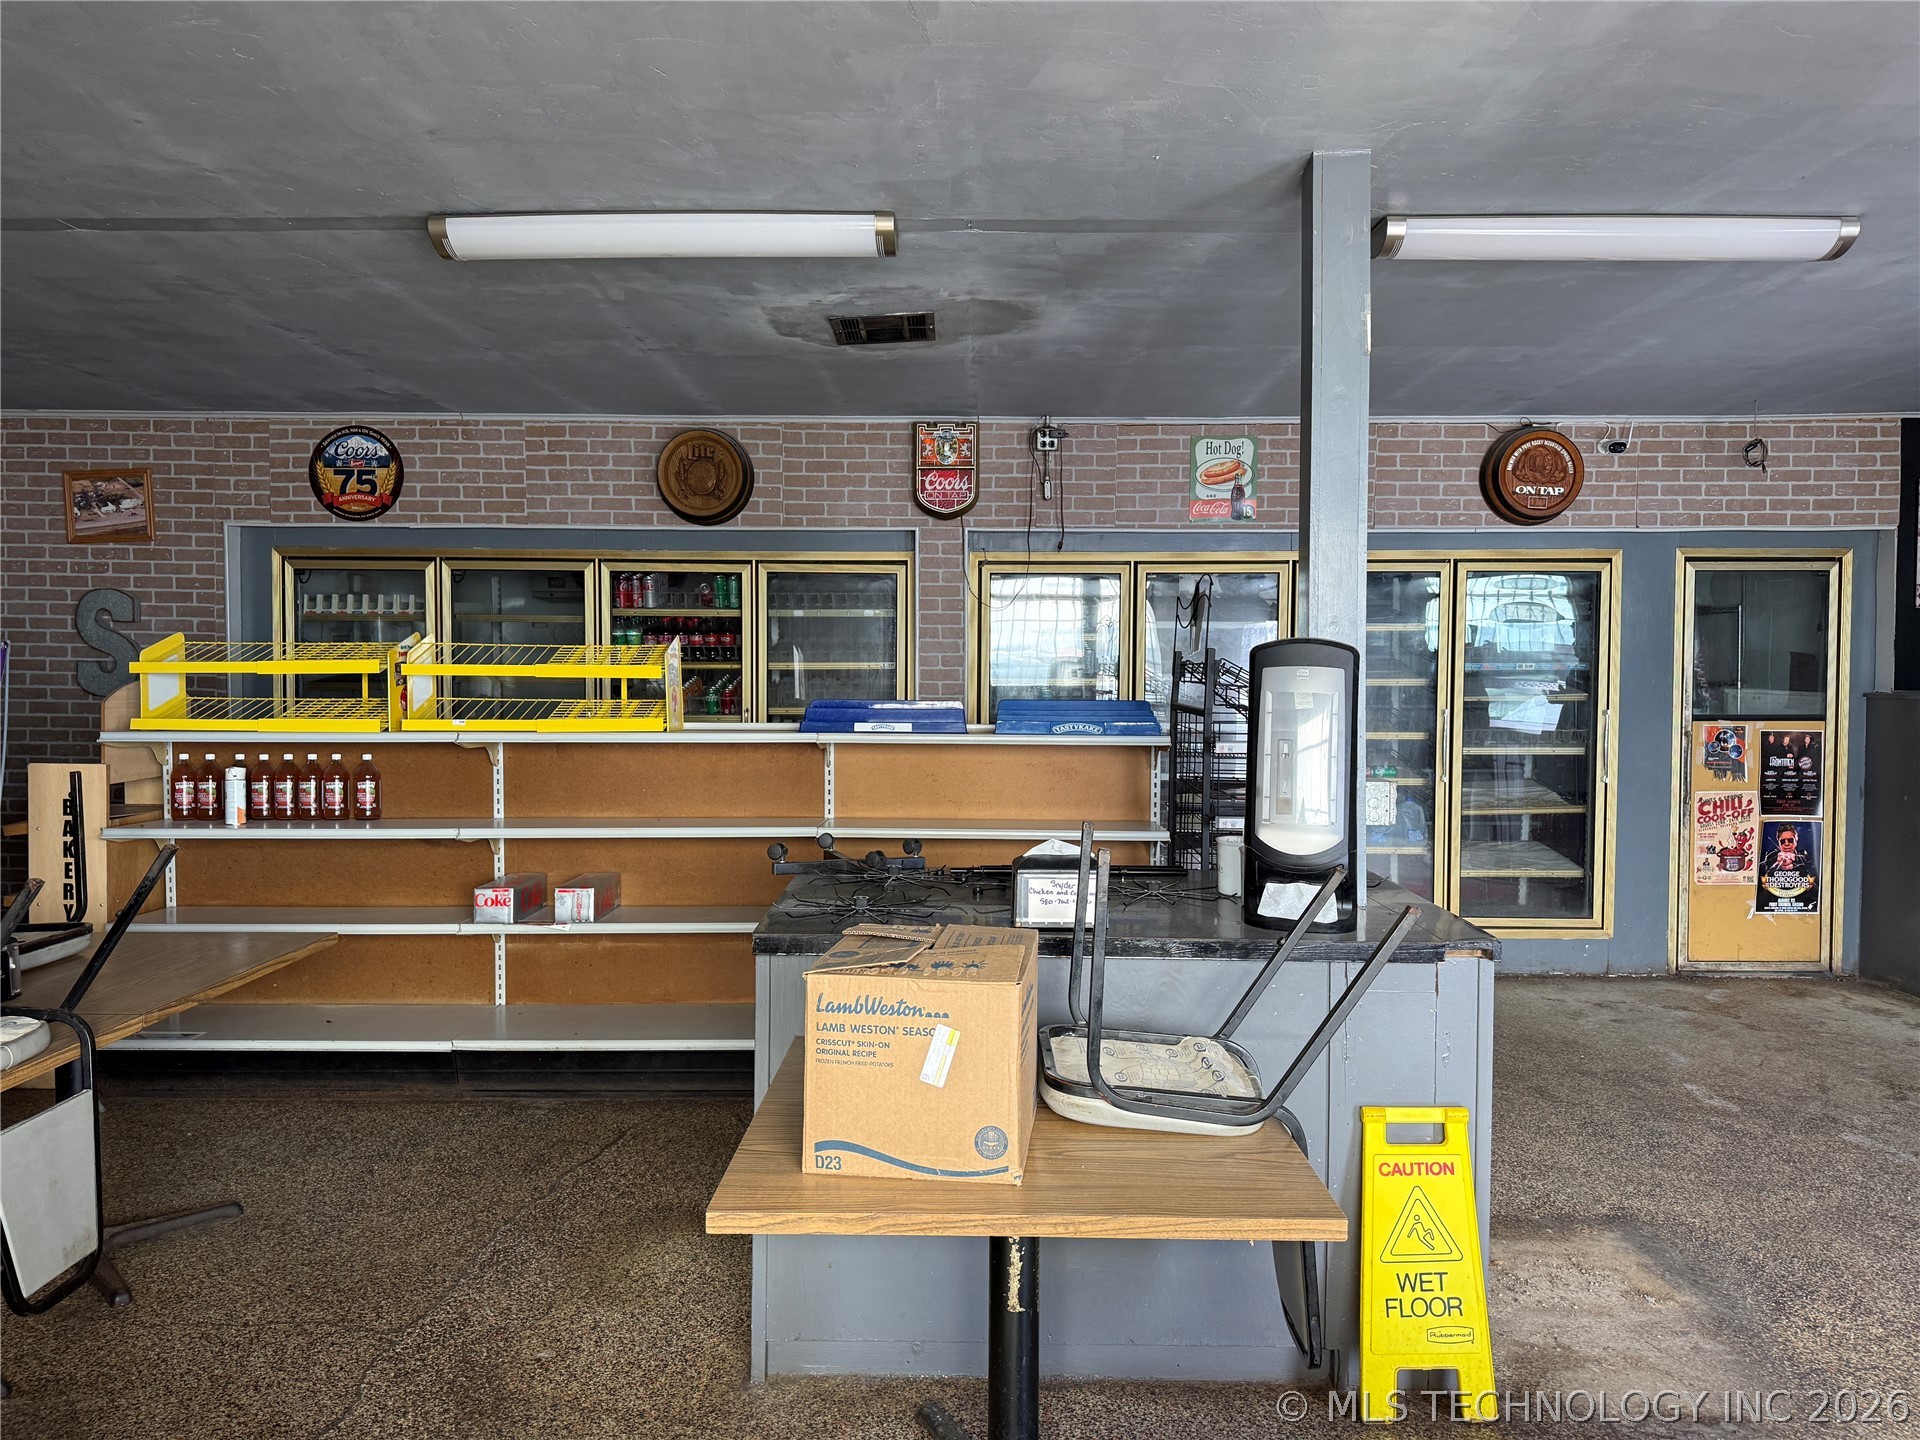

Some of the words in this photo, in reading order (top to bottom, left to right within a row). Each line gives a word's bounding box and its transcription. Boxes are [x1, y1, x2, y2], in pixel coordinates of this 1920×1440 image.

[334, 440, 380, 459] Coors
[683, 442, 715, 460] Lite
[1205, 441, 1222, 455] Hot
[1224, 441, 1245, 459] Dog!
[924, 472, 970, 490] Coors
[338, 494, 376, 502] ANNIVERSARY
[1515, 485, 1536, 494] ON
[1537, 486, 1565, 495] TAP
[75, 588, 141, 697] S
[1055, 723, 1100, 733] TASTYKAKE
[1697, 797, 1743, 816] CHILI
[1697, 807, 1754, 824] COOK-OFF
[63, 798, 75, 922] BAKERY
[1028, 887, 1053, 895] Chicken
[474, 893, 511, 908] Coke
[816, 1022, 846, 1033] LAMB
[816, 1048, 850, 1057] ORIGINAL
[852, 1050, 877, 1058] RECIPE
[856, 1041, 890, 1049] SKIN-ON
[815, 1154, 842, 1171] D23
[1378, 1161, 1455, 1177] CAUTION
[1396, 1272, 1448, 1293] WET
[1385, 1297, 1463, 1318] FLOOR
[1429, 1330, 1472, 1339] Rubbermaid
